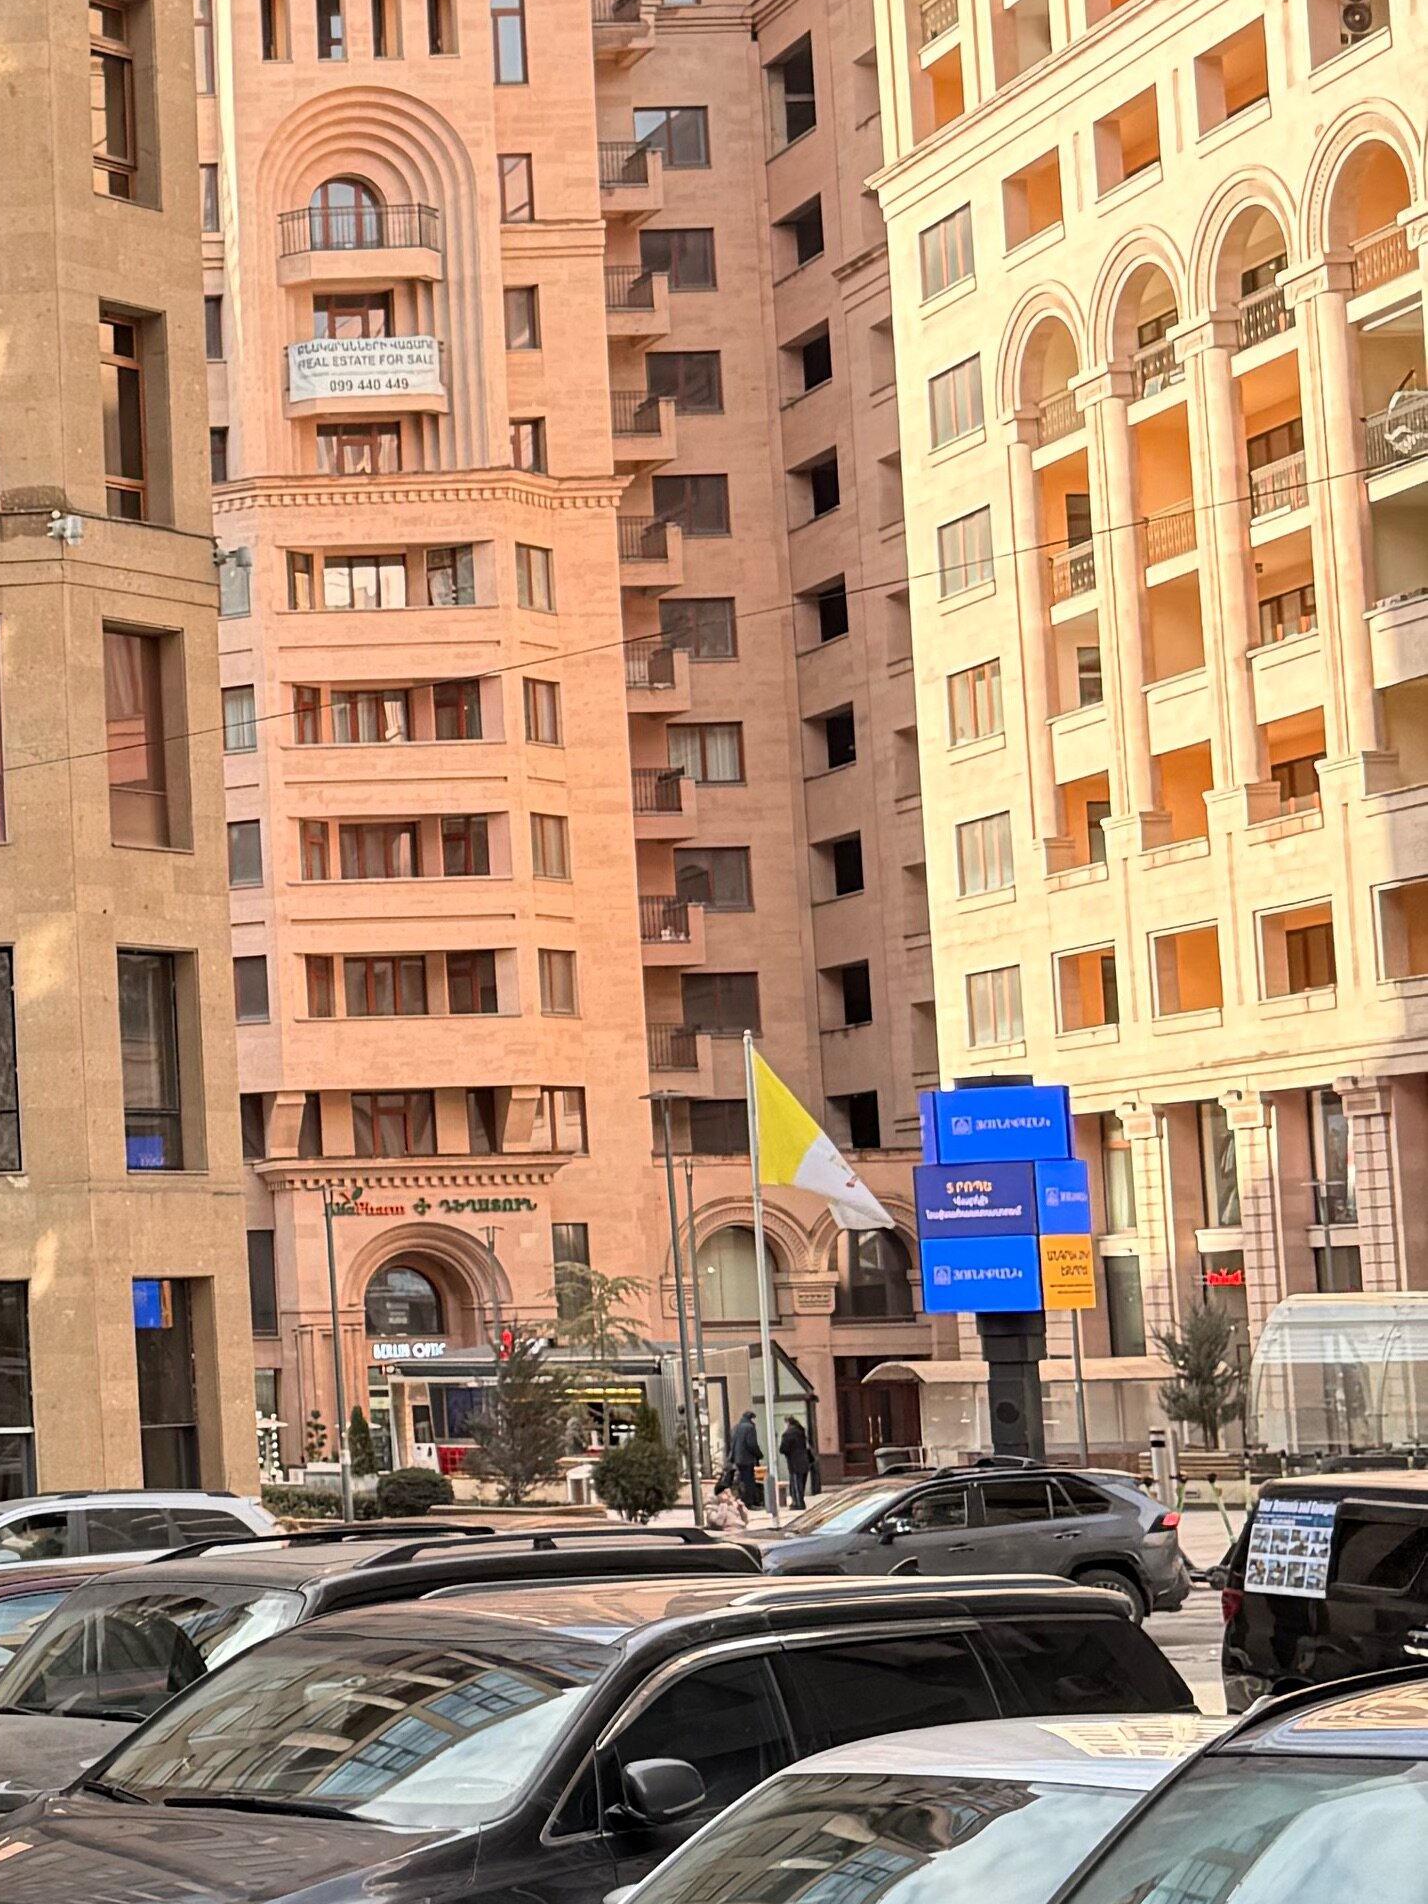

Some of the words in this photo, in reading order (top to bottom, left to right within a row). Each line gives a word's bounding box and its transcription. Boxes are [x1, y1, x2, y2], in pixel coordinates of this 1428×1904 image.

[298, 356, 329, 370] REAL
[333, 355, 376, 367] ESTATE
[379, 354, 404, 366] FOR
[407, 353, 434, 365] SALE
[330, 379, 354, 392] 099
[357, 378, 381, 391] 440
[385, 377, 409, 390] 449
